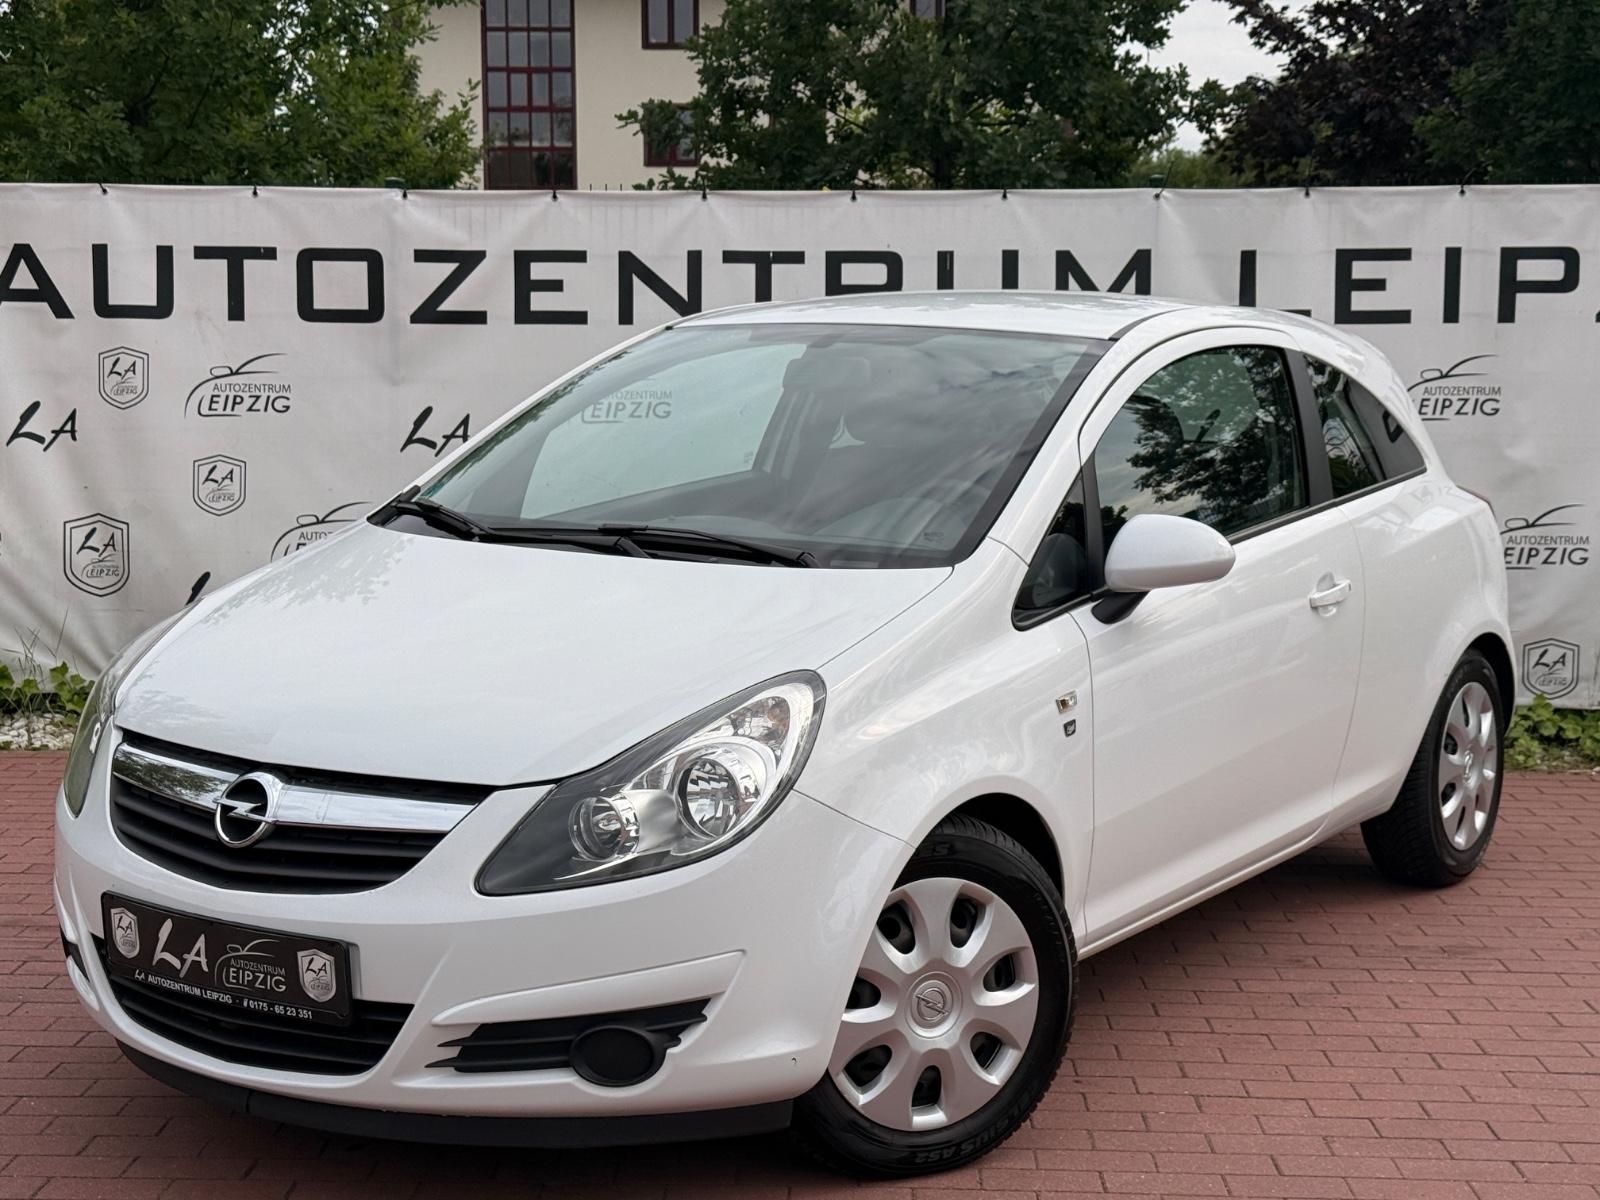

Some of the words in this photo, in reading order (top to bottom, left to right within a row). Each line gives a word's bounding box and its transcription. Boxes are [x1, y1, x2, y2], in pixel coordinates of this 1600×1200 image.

[1239, 246, 1600, 325] LEIP
[107, 357, 137, 379] LA
[212, 383, 291, 393] AUTOZENTRUM
[1423, 386, 1501, 396] AUTOZENTRUM
[6, 401, 77, 452] LA
[400, 406, 470, 457] LA
[202, 464, 234, 487] LA
[76, 527, 117, 557] LA
[1506, 536, 1589, 545] AUTOZENTRUM
[1532, 648, 1567, 671] LA
[152, 918, 208, 978] LA
[230, 958, 286, 976] AUTOZENTRUM
[305, 957, 328, 977] LA
[148, 974, 201, 996] AUTOZENTRUM
[202, 989, 232, 1003] LEIPZIG
[249, 1000, 268, 1011] 0175
[275, 1005, 285, 1014] 65
[286, 1007, 296, 1016] 23
[298, 1009, 312, 1019] 351
